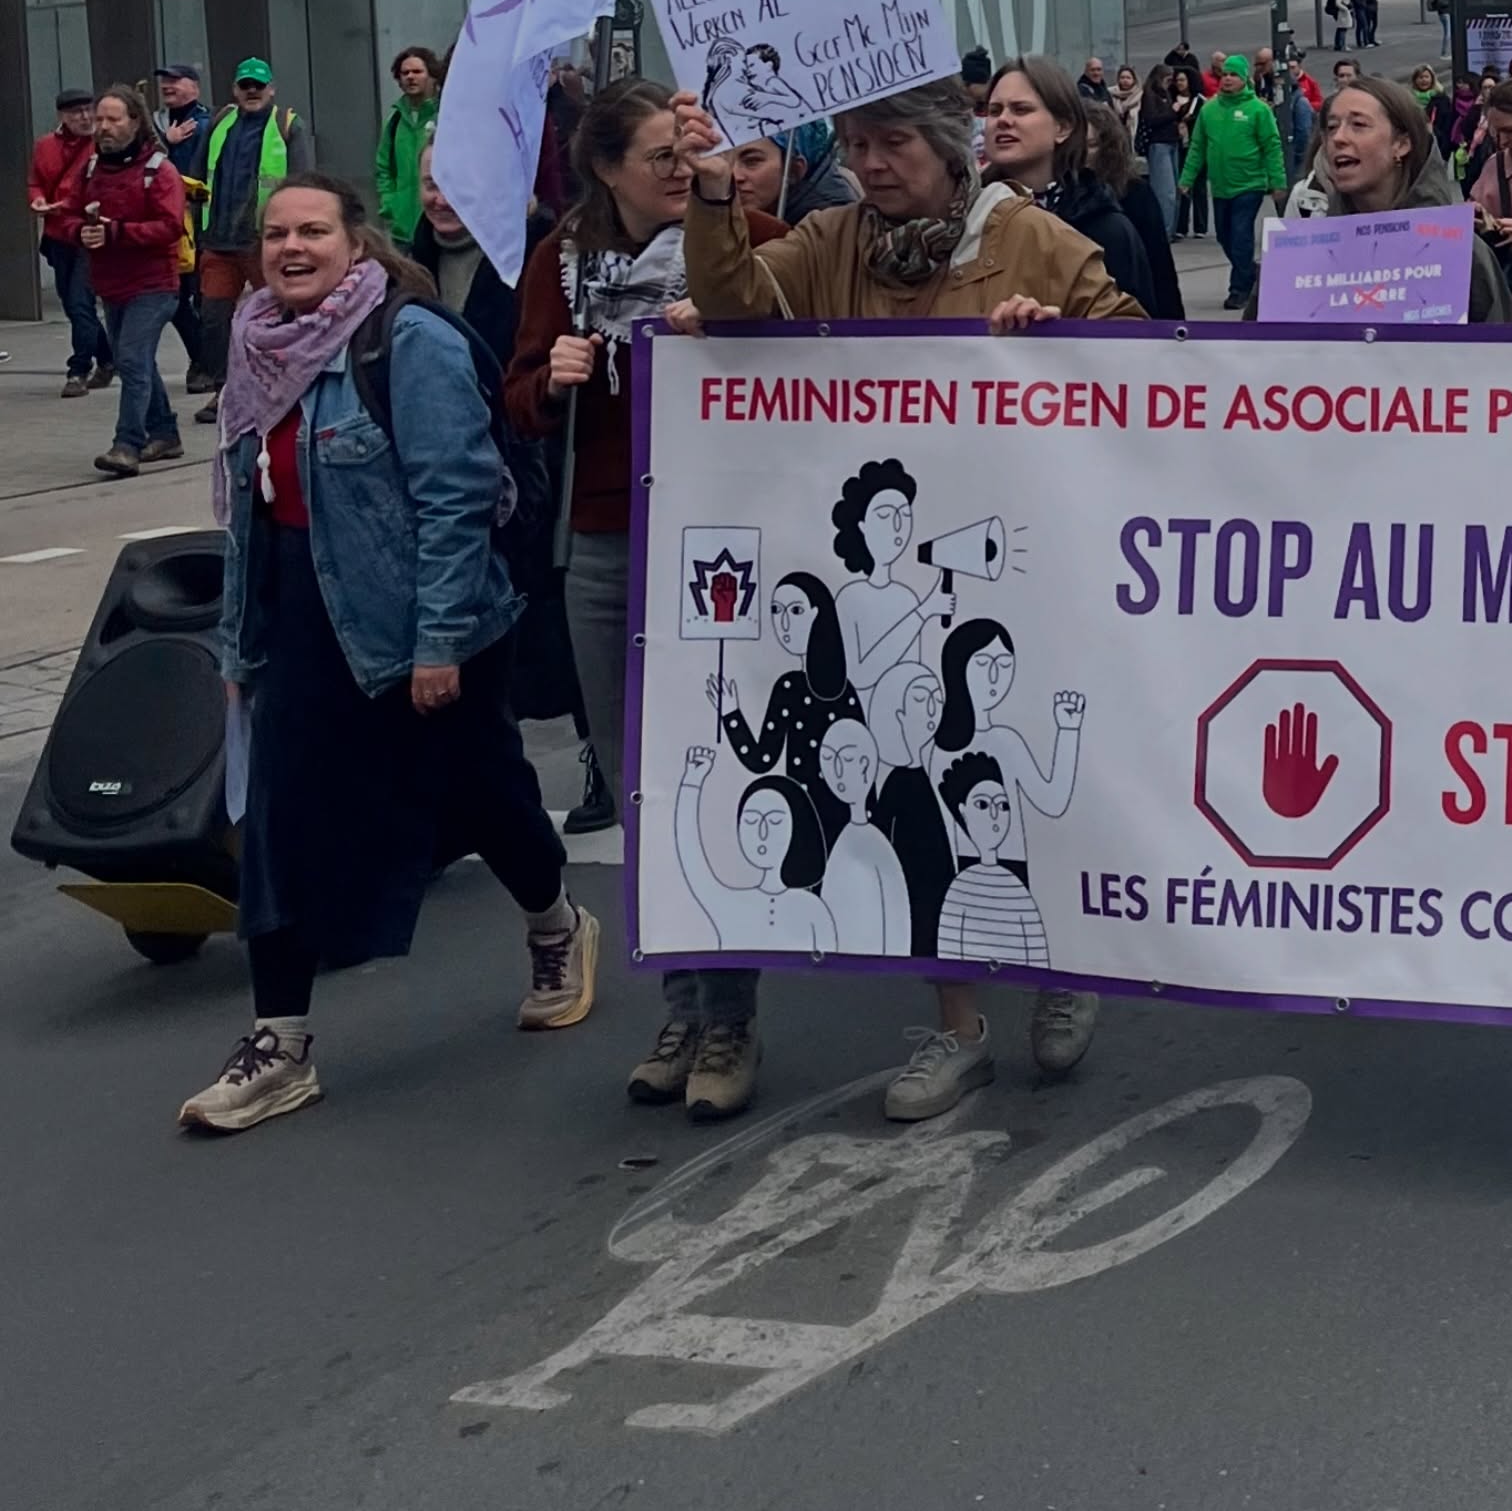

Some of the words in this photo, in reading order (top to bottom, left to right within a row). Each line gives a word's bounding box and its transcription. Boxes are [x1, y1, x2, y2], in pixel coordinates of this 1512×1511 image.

[1295, 274, 1322, 289] DES
[1326, 267, 1401, 288] MILLIARDS
[1404, 263, 1442, 281] POUR
[1330, 292, 1349, 307] LA
[700, 377, 957, 425] FEMINISTEN
[972, 380, 1128, 429] TEGEN
[1147, 384, 1207, 430] DE
[1223, 384, 1469, 434] ASOCIALE
[1116, 516, 1313, 619] STOP
[1334, 522, 1434, 623] AU
[1080, 871, 1148, 921] LES
[1166, 866, 1443, 938] FÉMINISTES
